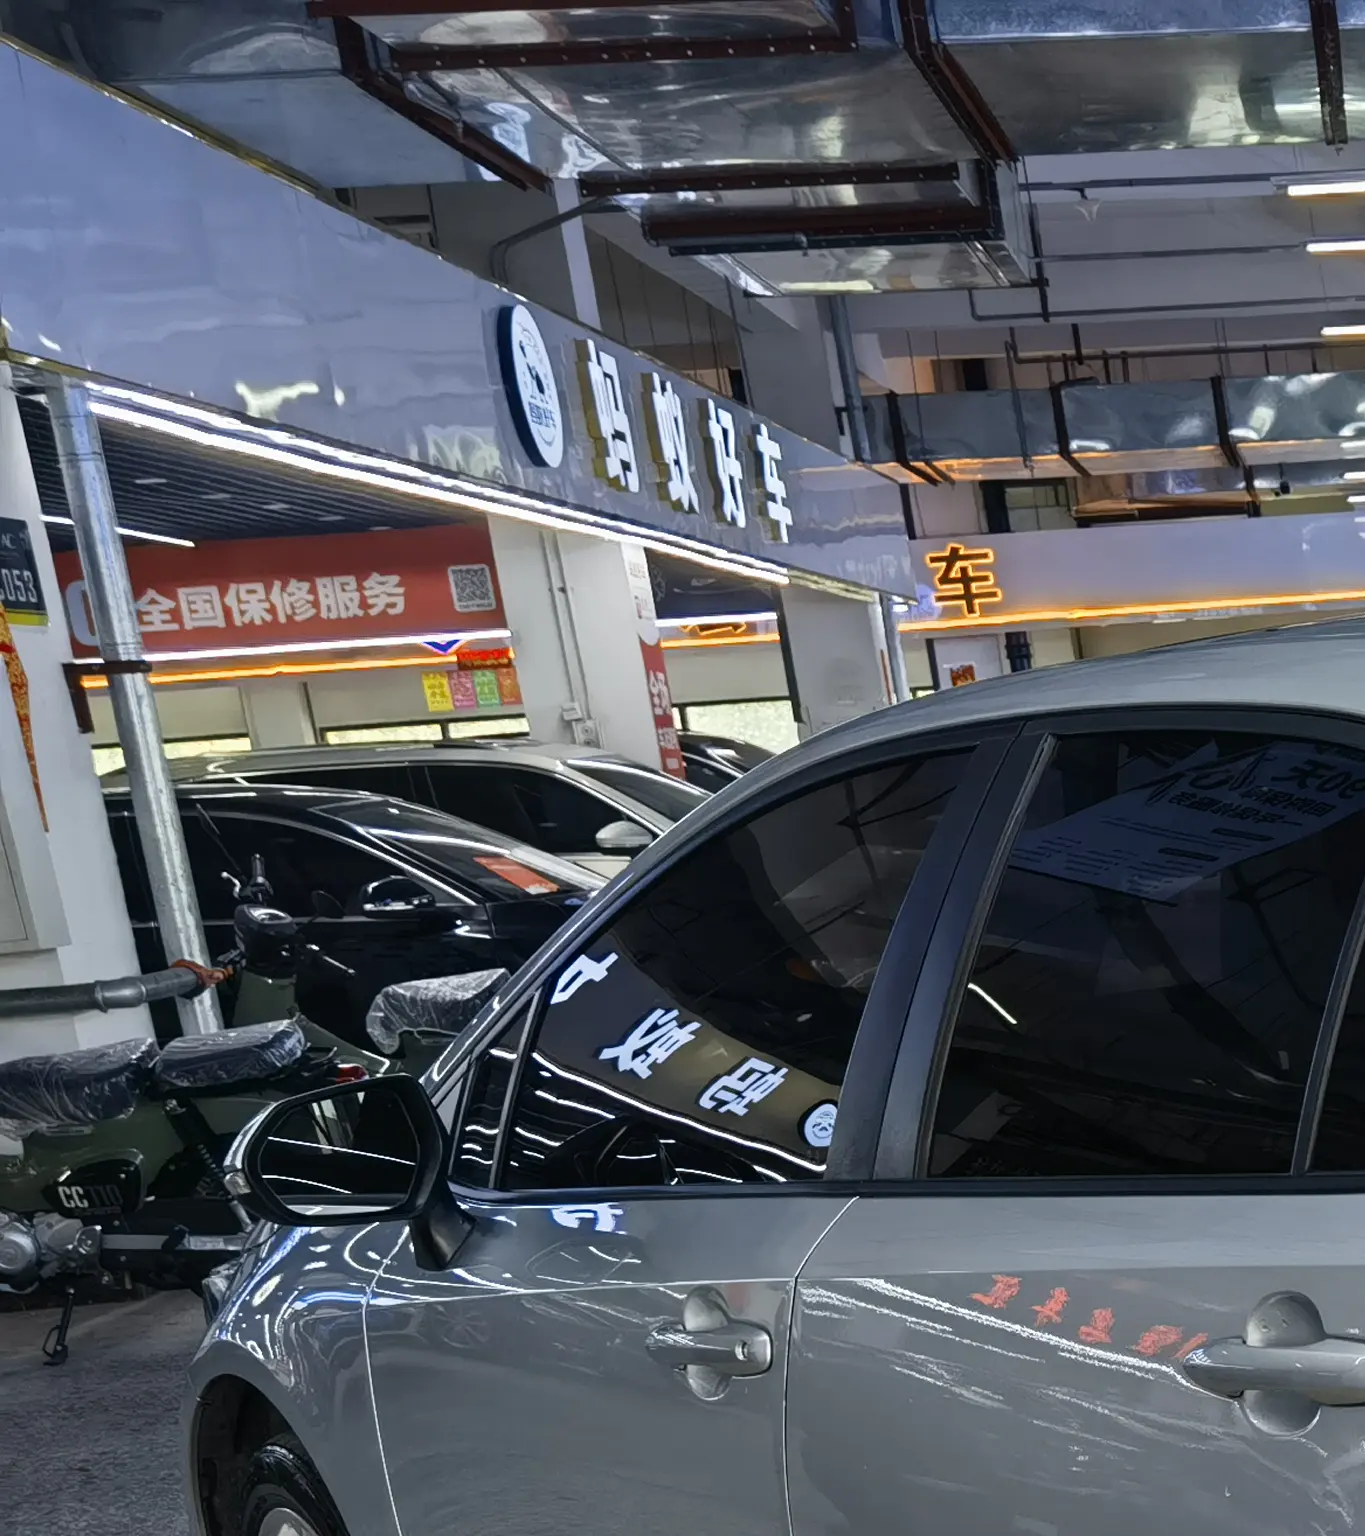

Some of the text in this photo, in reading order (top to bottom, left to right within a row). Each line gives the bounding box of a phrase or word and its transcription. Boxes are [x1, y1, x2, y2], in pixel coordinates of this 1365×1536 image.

[586, 337, 794, 544] 蚂蚁好车
[136, 570, 407, 634] 全国保修服务
[926, 543, 1003, 618] 车
